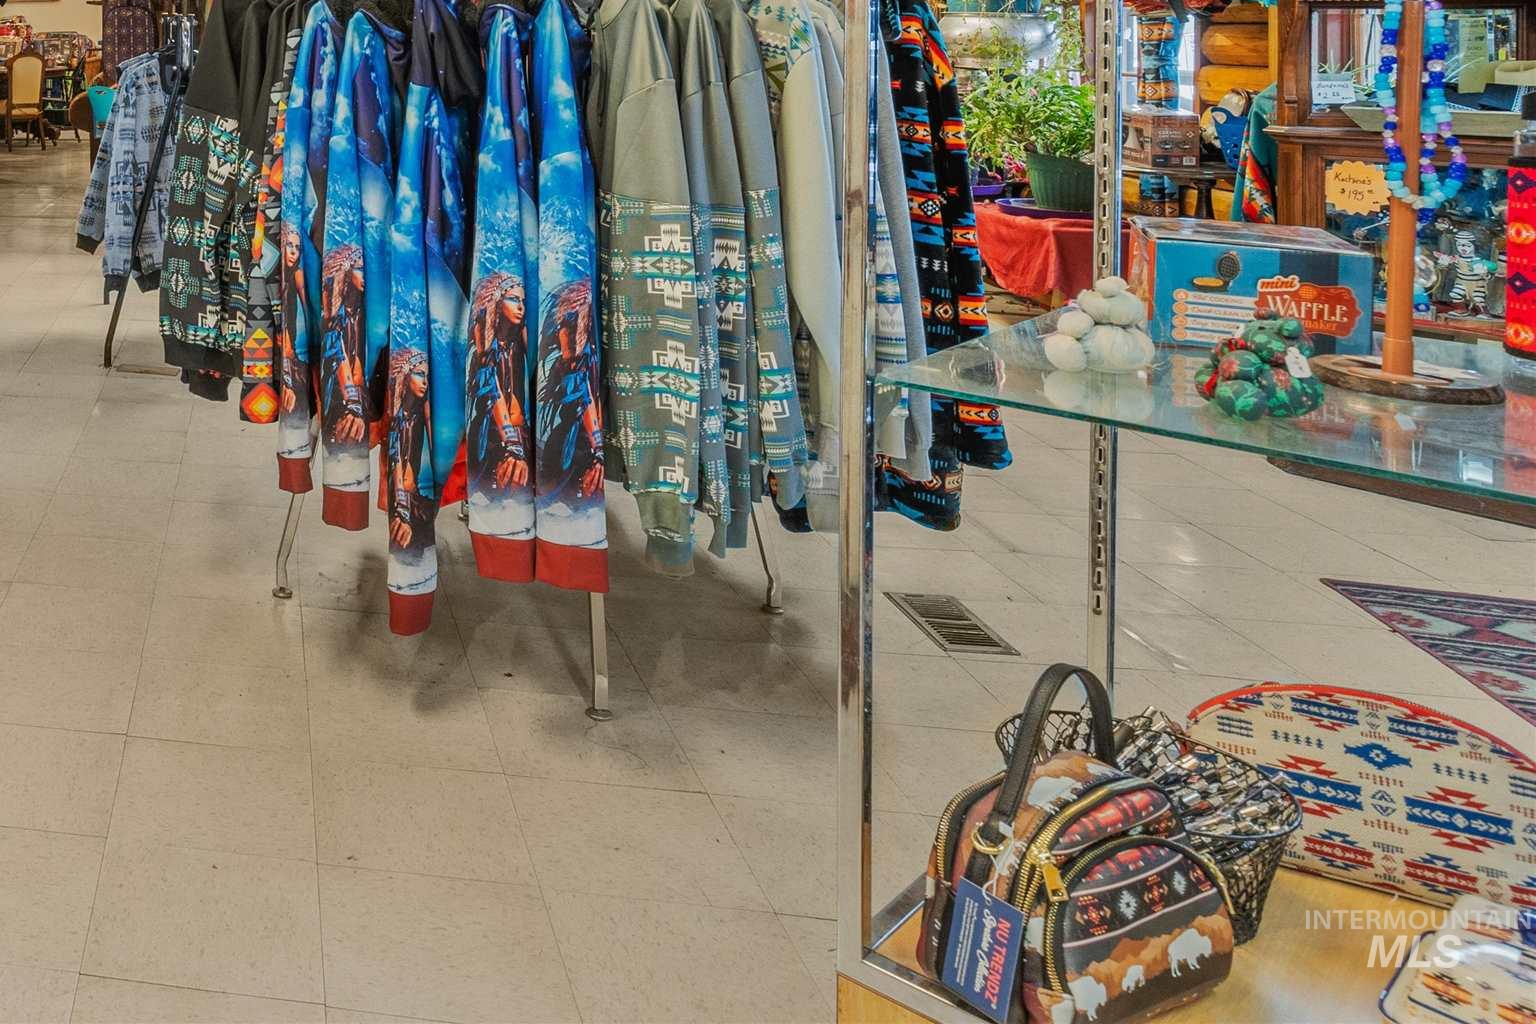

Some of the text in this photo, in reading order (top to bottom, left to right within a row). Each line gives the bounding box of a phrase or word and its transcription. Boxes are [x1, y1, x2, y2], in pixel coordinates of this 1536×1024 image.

[1259, 277, 1297, 290] mini
[1265, 294, 1350, 323] WAFFLE
[995, 918, 1012, 944] NU
